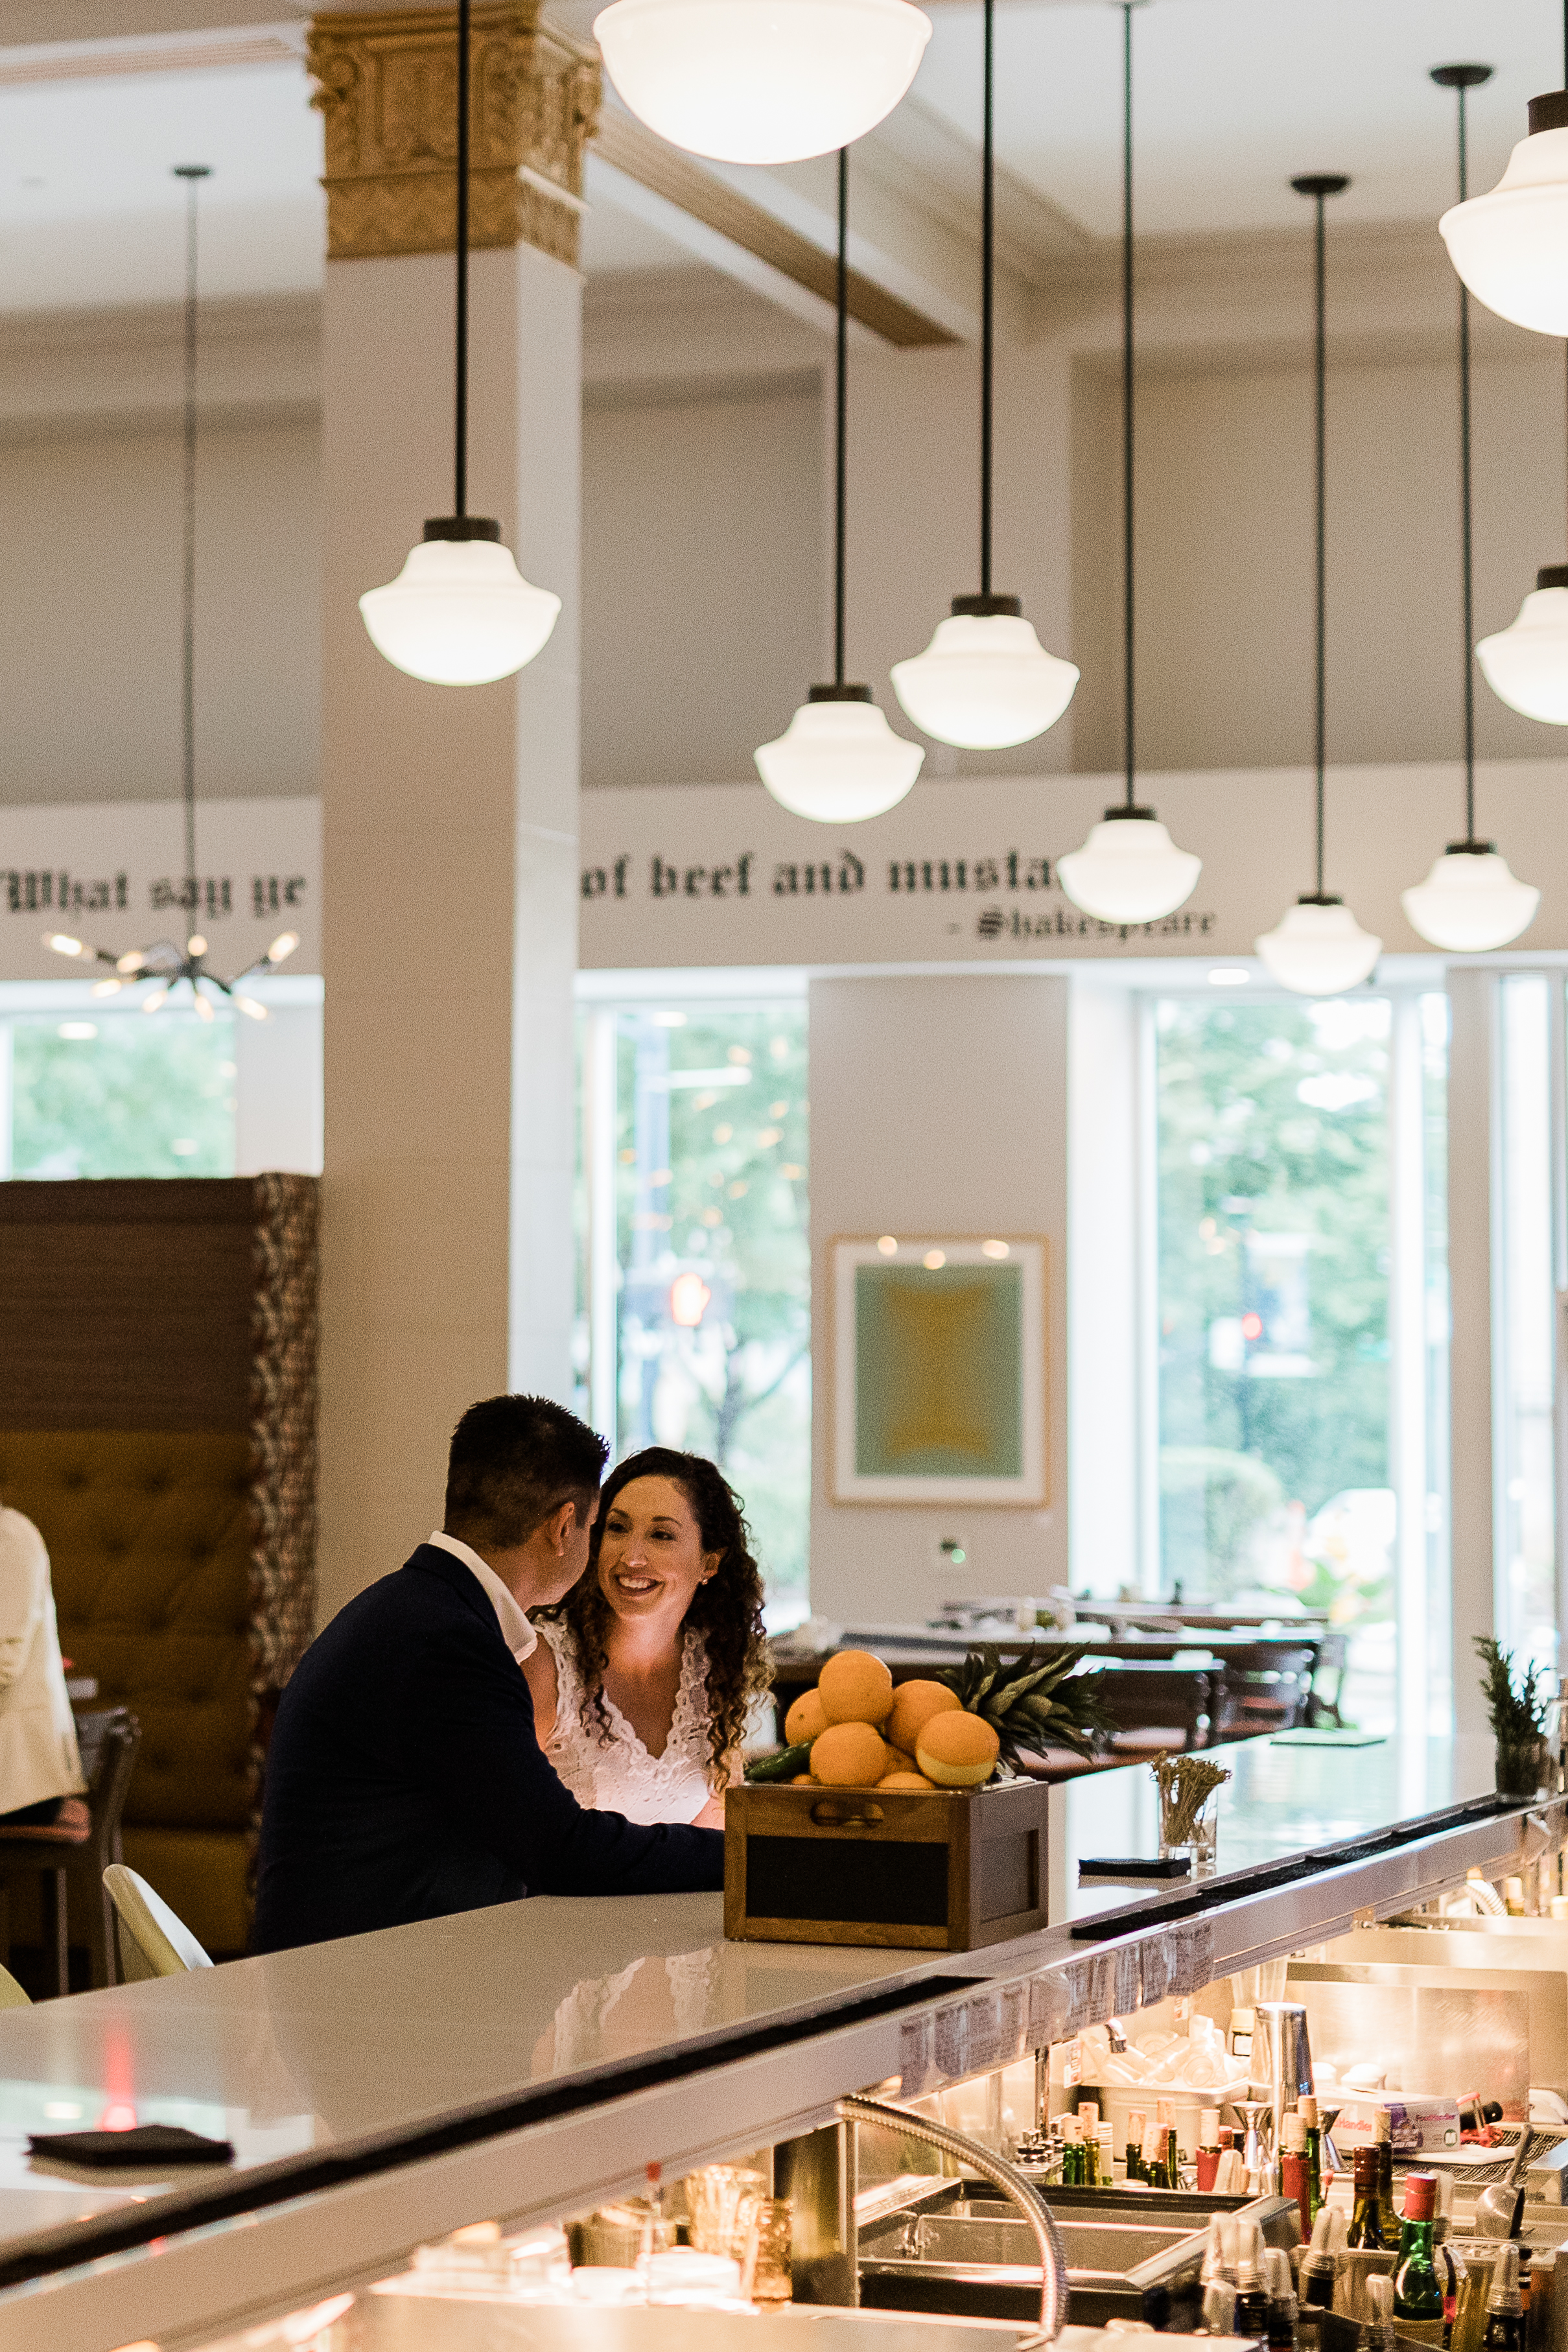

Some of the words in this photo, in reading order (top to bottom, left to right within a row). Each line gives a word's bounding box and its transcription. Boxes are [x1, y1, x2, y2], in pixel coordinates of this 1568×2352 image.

[150, 875, 232, 919] say
[252, 875, 307, 919] ye
[582, 851, 631, 899] of
[651, 851, 755, 899] beef
[774, 848, 865, 897] and
[887, 849, 1060, 892] musta
